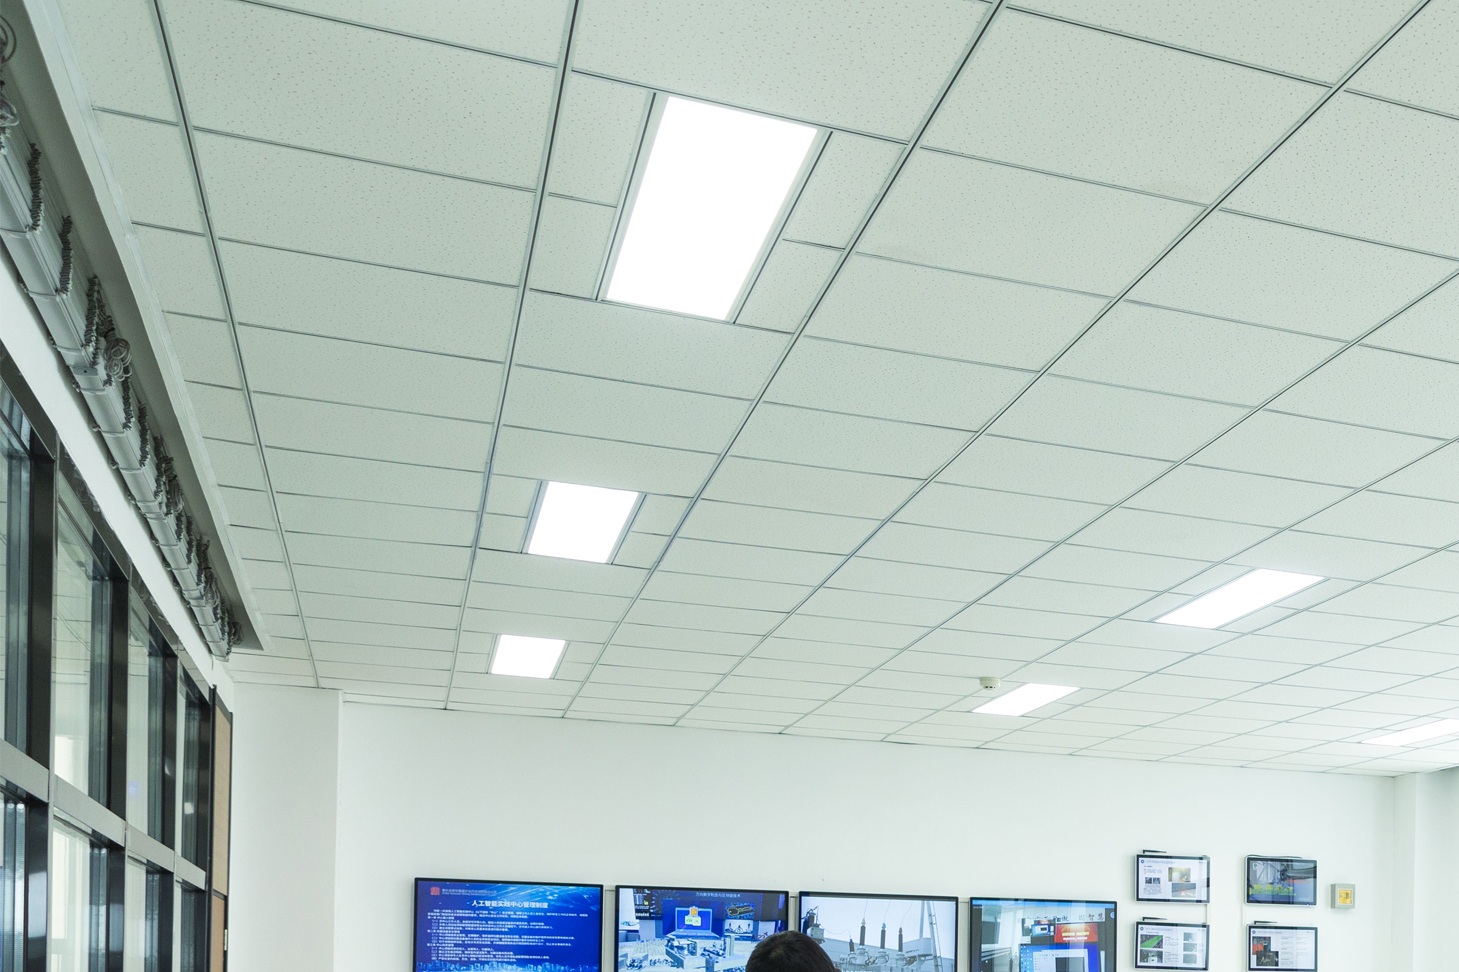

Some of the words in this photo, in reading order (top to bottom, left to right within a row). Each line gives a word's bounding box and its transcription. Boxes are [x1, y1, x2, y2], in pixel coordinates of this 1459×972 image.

[471, 900, 549, 909] 人工智能实践中心管理制度
